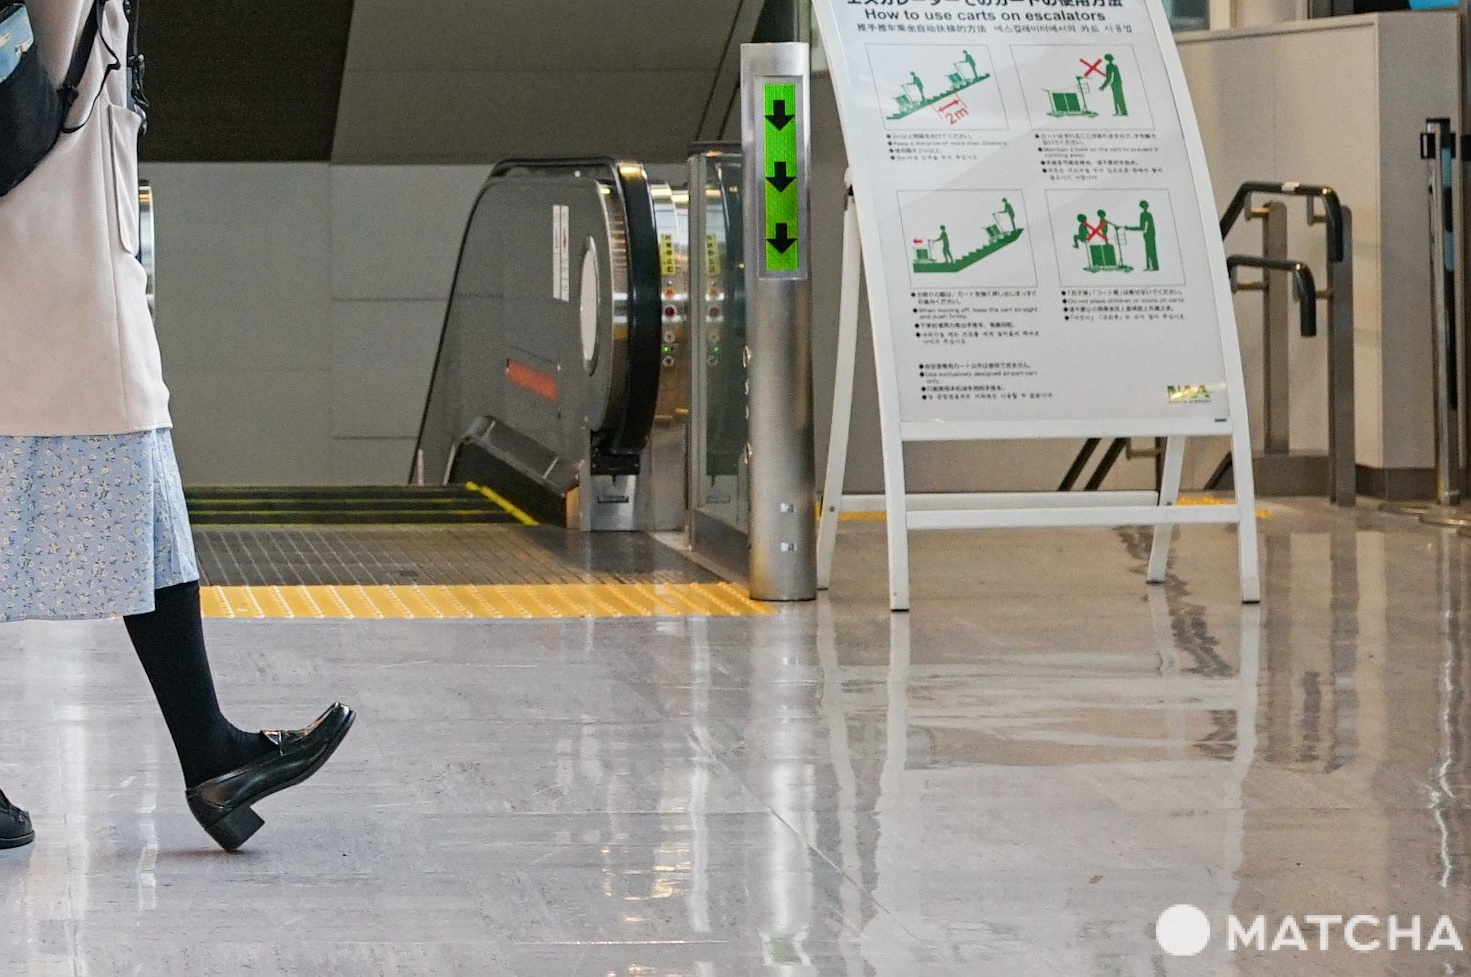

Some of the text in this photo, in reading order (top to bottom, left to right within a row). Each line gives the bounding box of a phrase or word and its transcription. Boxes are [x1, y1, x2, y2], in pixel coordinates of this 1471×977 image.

[864, 8, 1106, 21] How to use carts on escalators
[945, 107, 970, 125] 2m
